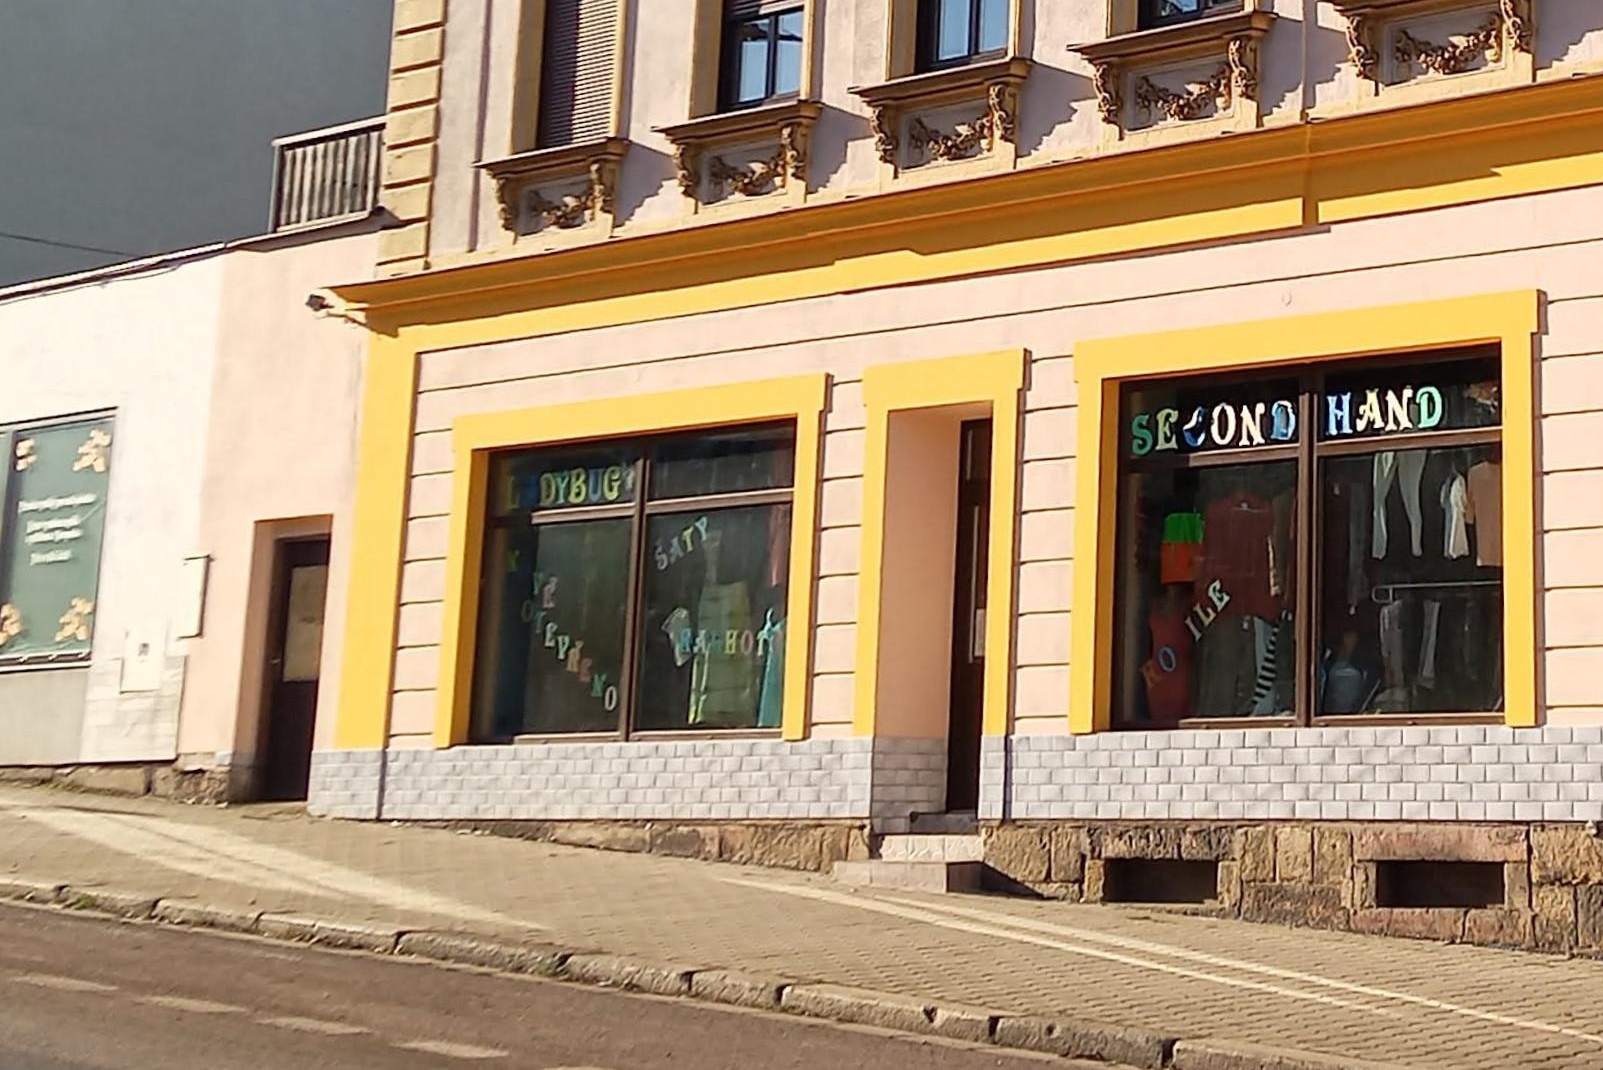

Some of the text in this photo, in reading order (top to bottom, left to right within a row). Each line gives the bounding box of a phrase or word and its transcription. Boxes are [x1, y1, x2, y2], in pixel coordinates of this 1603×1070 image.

[1131, 385, 1444, 456] SECOND HAND
[507, 465, 621, 509] LDYBUG
